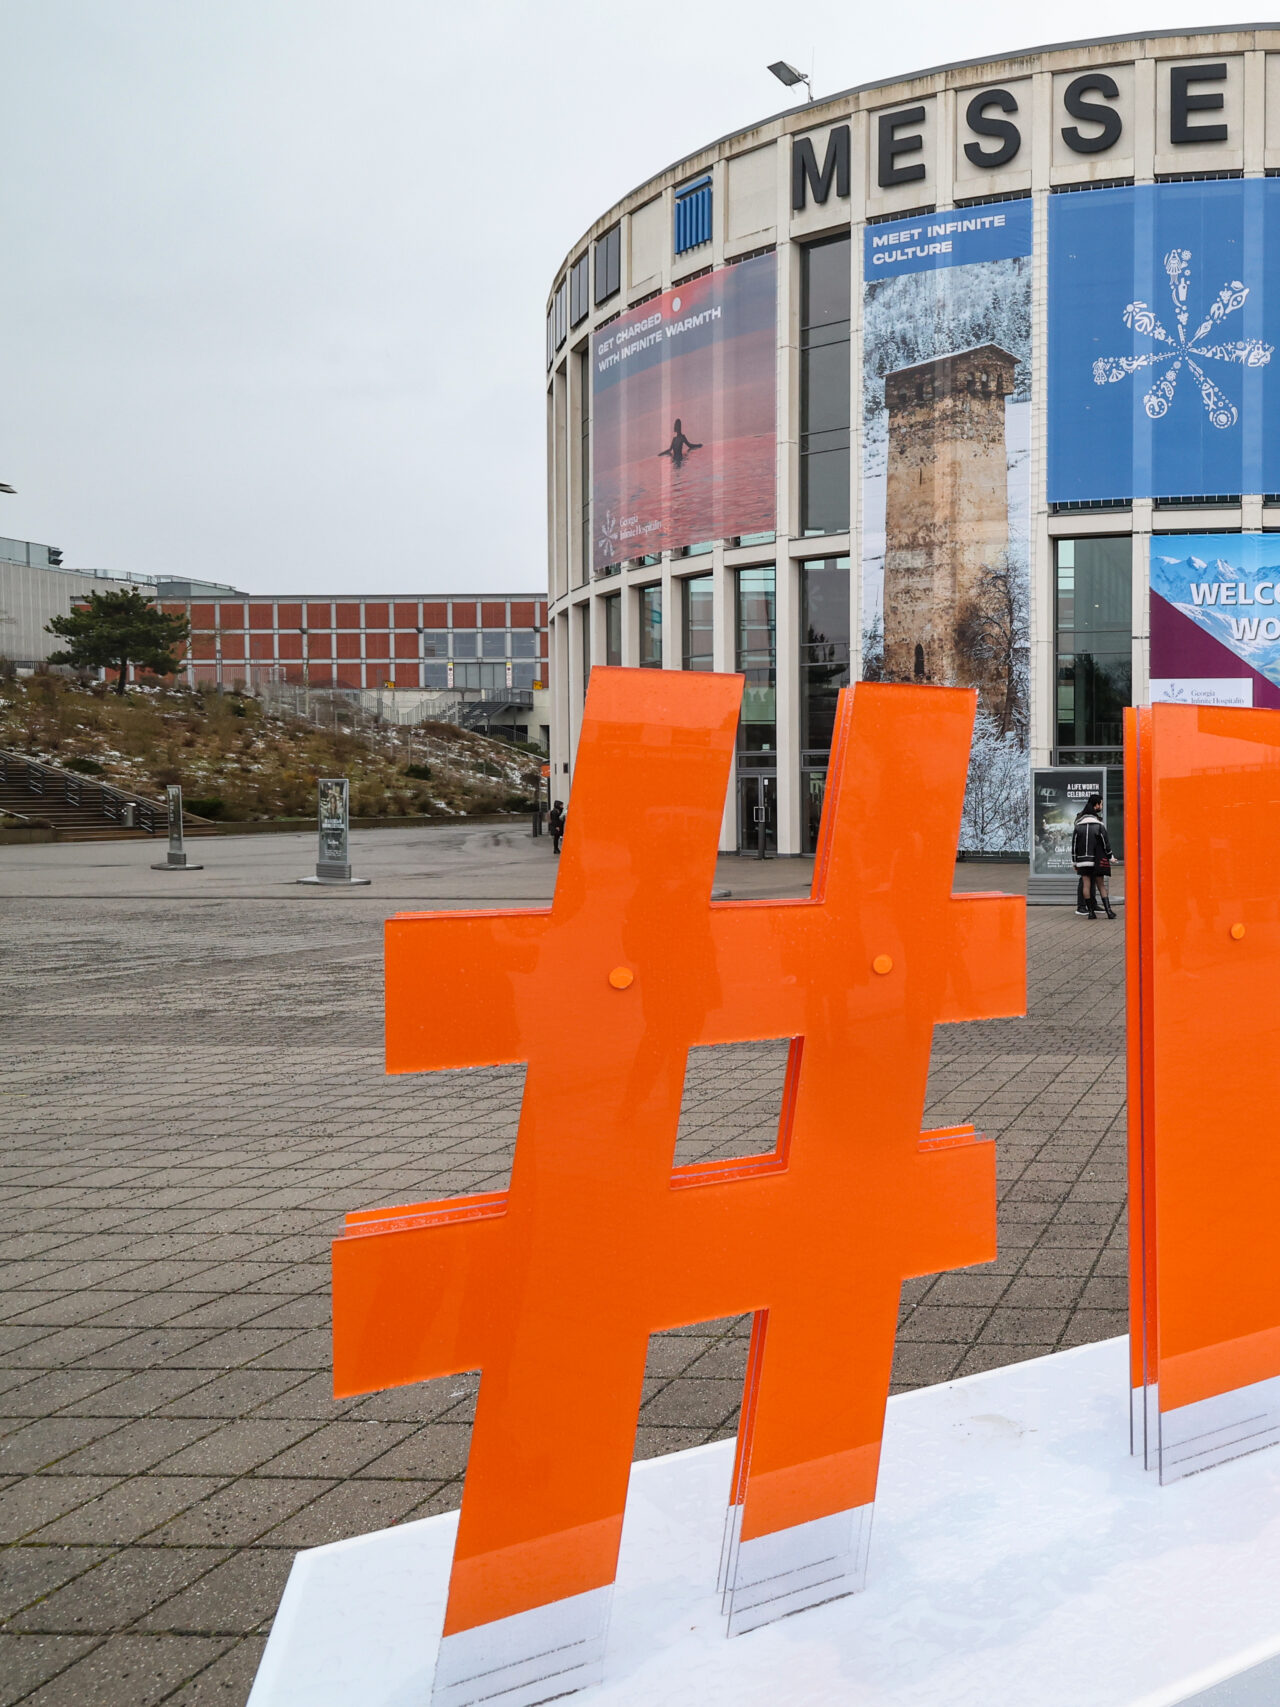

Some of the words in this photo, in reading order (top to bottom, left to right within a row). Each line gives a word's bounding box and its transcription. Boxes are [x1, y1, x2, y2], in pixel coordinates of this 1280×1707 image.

[792, 62, 1229, 211] MESSE
[872, 229, 923, 248] MEET
[927, 215, 1006, 238] INFINITE
[872, 241, 953, 265] CULTURE
[598, 337, 614, 356] GET
[616, 312, 662, 345] CHARGED
[598, 351, 620, 373] WITH
[621, 330, 663, 360] INFINITE
[665, 306, 722, 338] WARMTH
